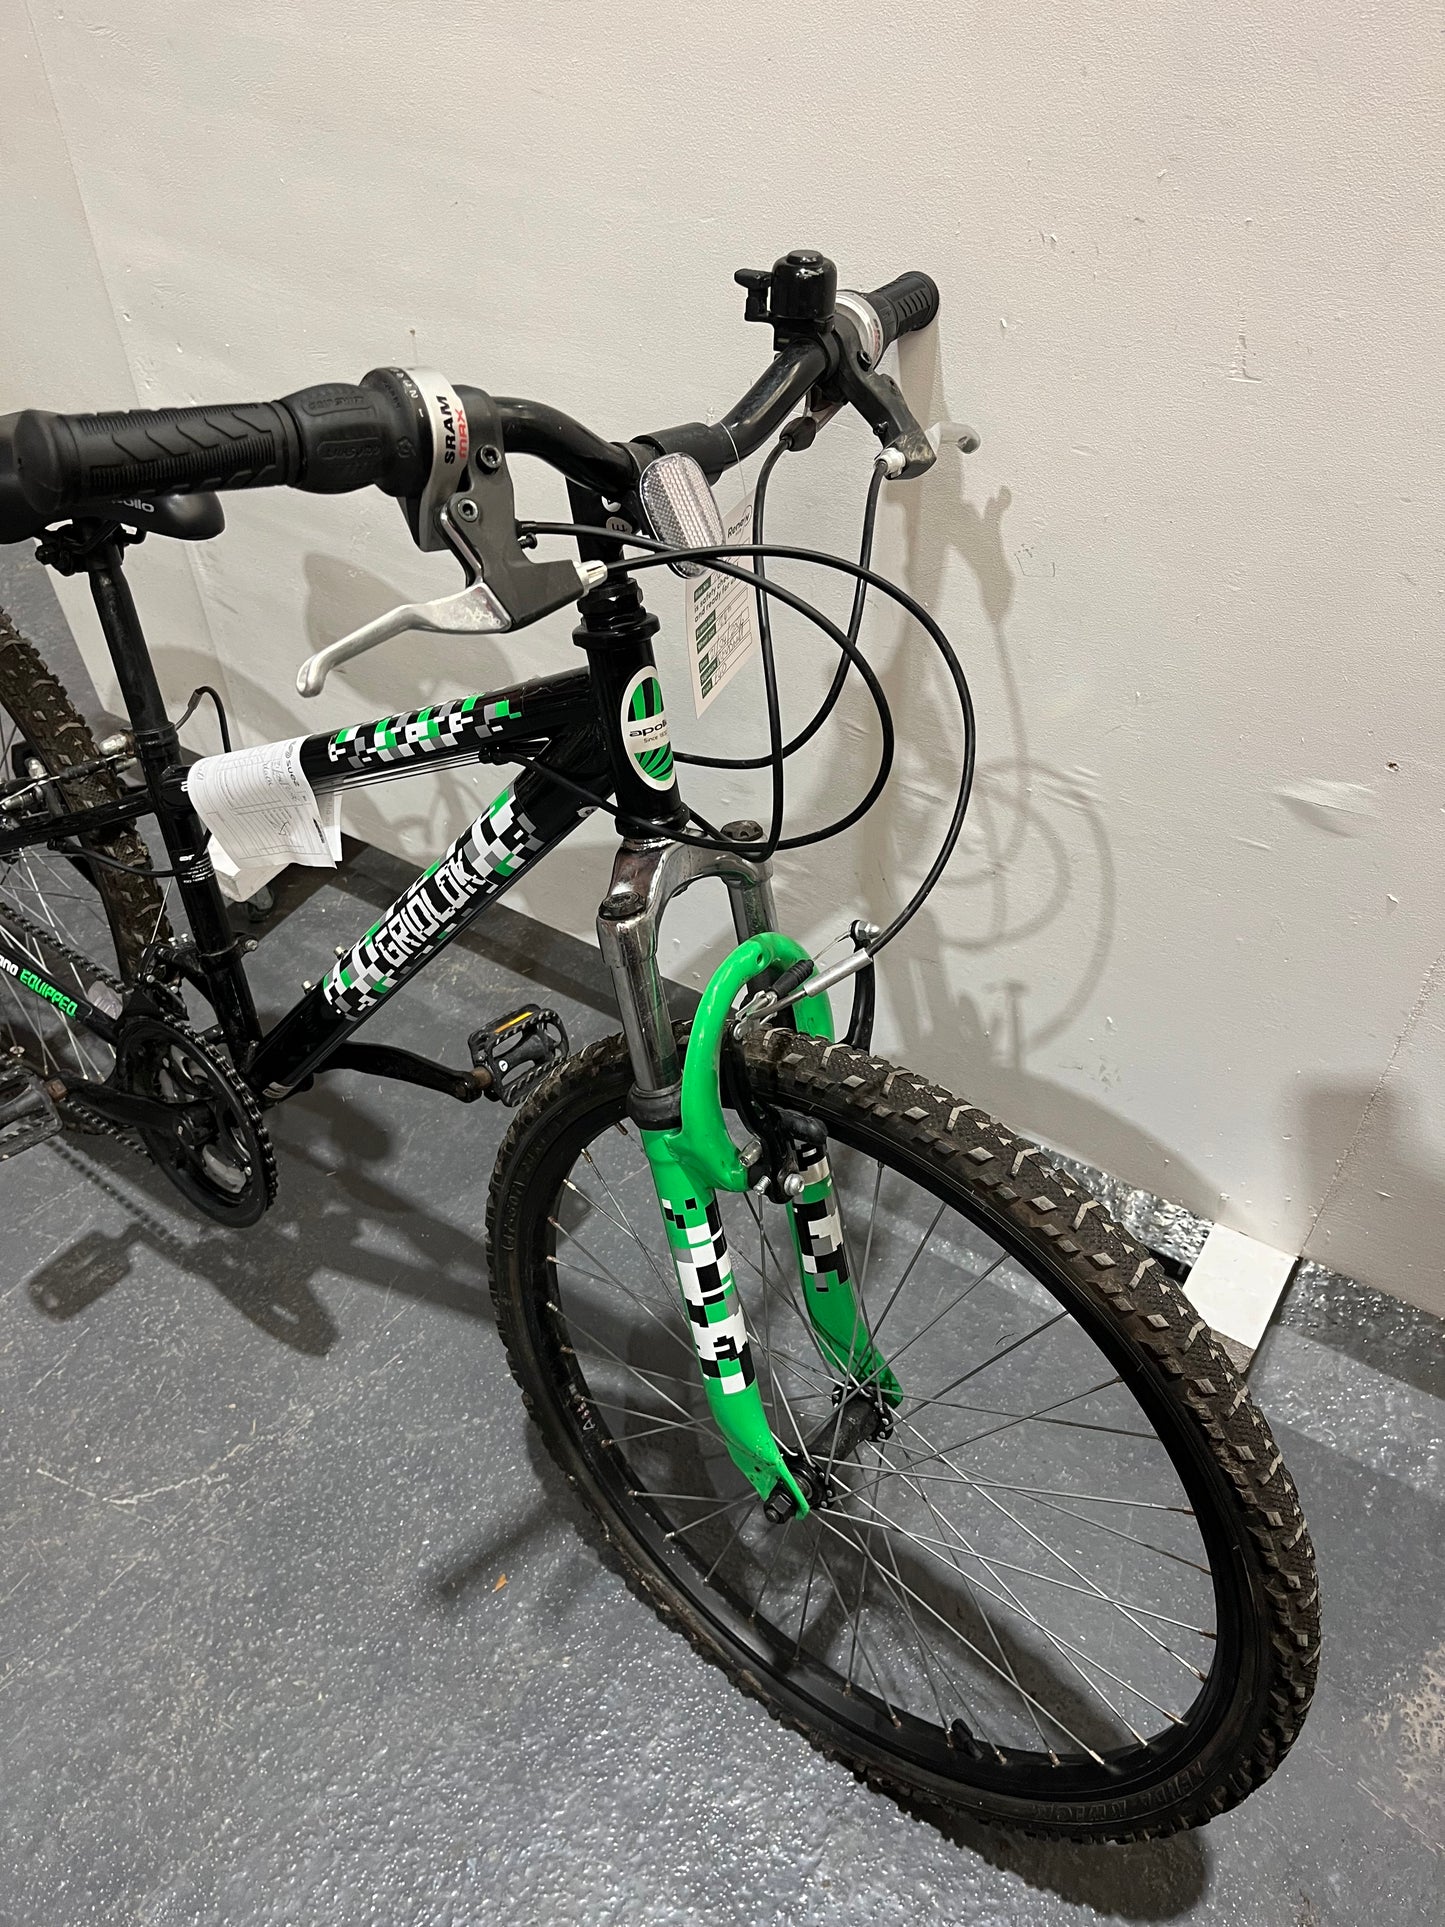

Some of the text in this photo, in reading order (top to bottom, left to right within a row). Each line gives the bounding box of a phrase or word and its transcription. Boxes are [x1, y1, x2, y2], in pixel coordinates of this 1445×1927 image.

[435, 395, 456, 465] SRAM
[112, 499, 155, 513] ollo
[695, 605, 706, 622] and
[706, 591, 721, 611] ready
[700, 587, 716, 608] safety
[629, 719, 668, 738] apoll
[286, 759, 300, 787] suez
[374, 847, 486, 968] GRIDLOK
[20, 967, 78, 1017] EQUIPPED
